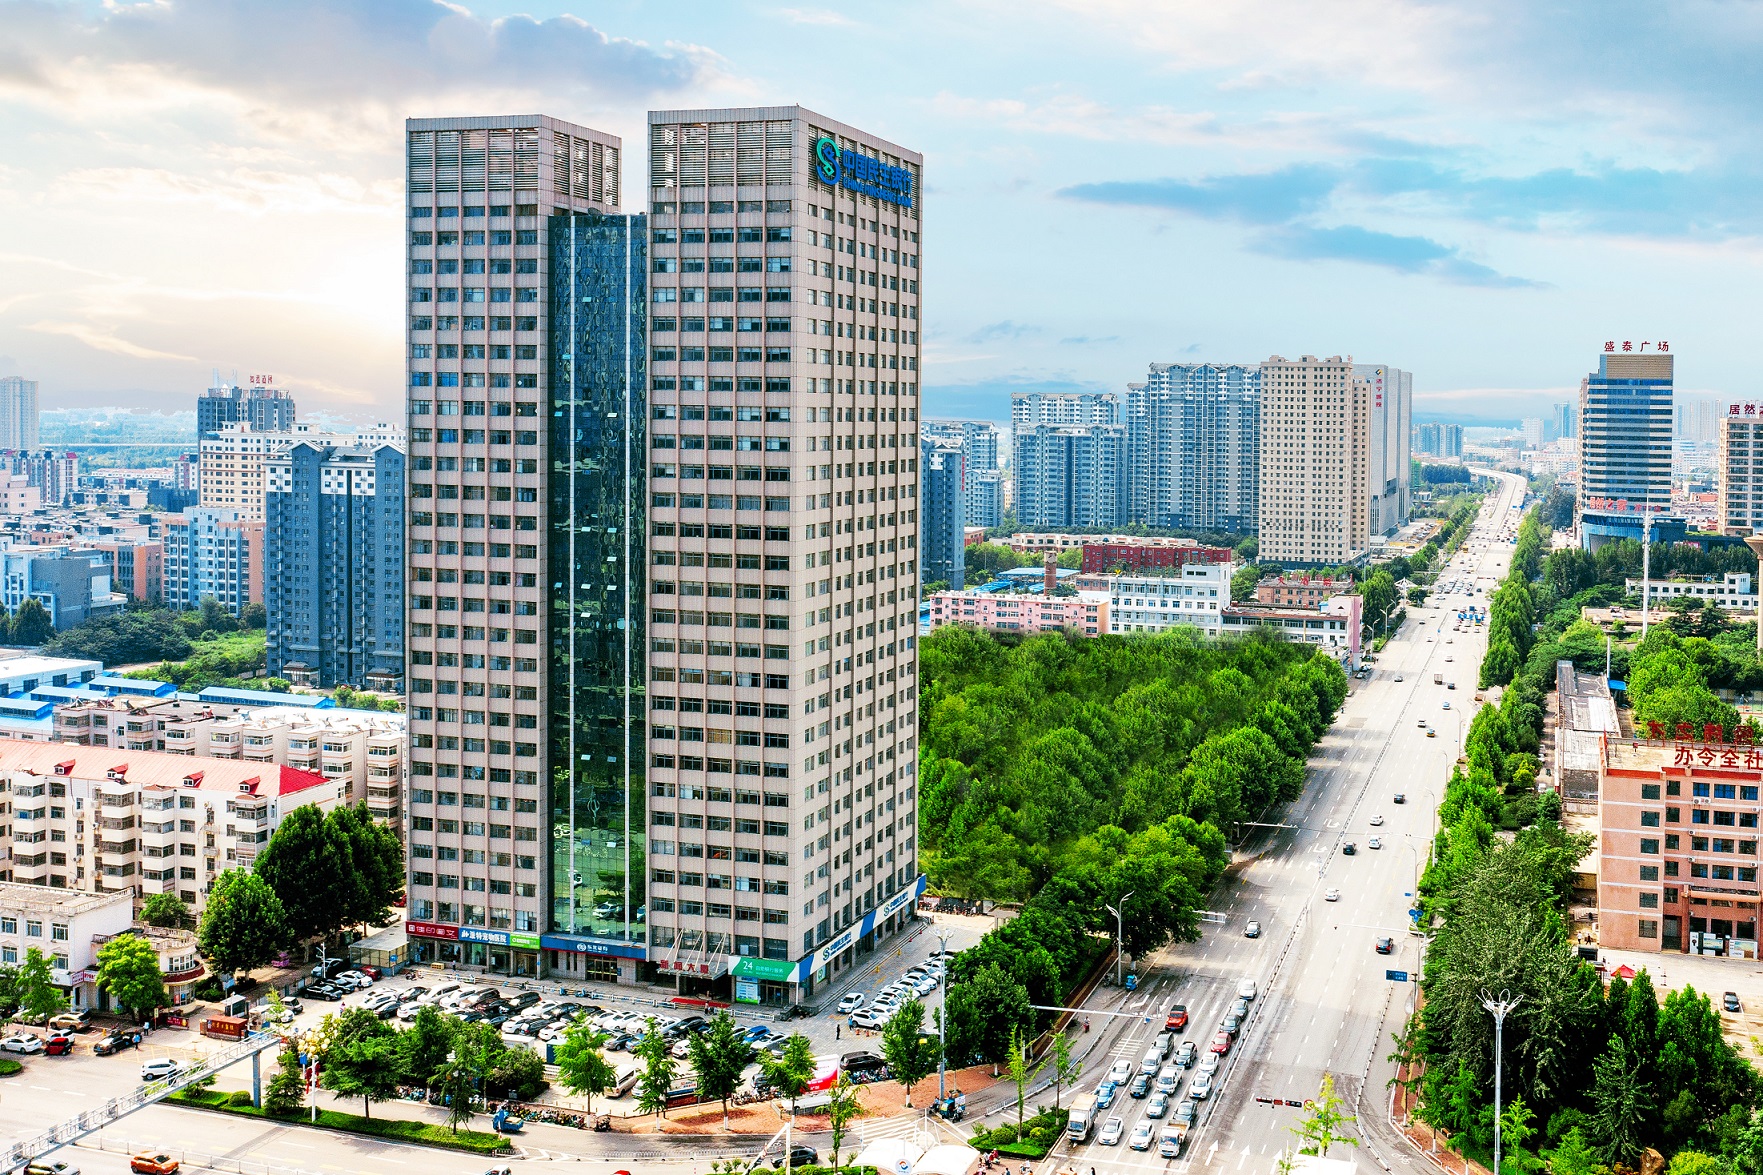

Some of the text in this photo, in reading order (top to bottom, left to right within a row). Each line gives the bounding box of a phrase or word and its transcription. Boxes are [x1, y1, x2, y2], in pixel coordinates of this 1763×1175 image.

[843, 148, 912, 194] 中国民生银行
[1604, 341, 1669, 352] 盛泰广场
[1589, 496, 1627, 511] 居然之家
[743, 960, 753, 970] 24
